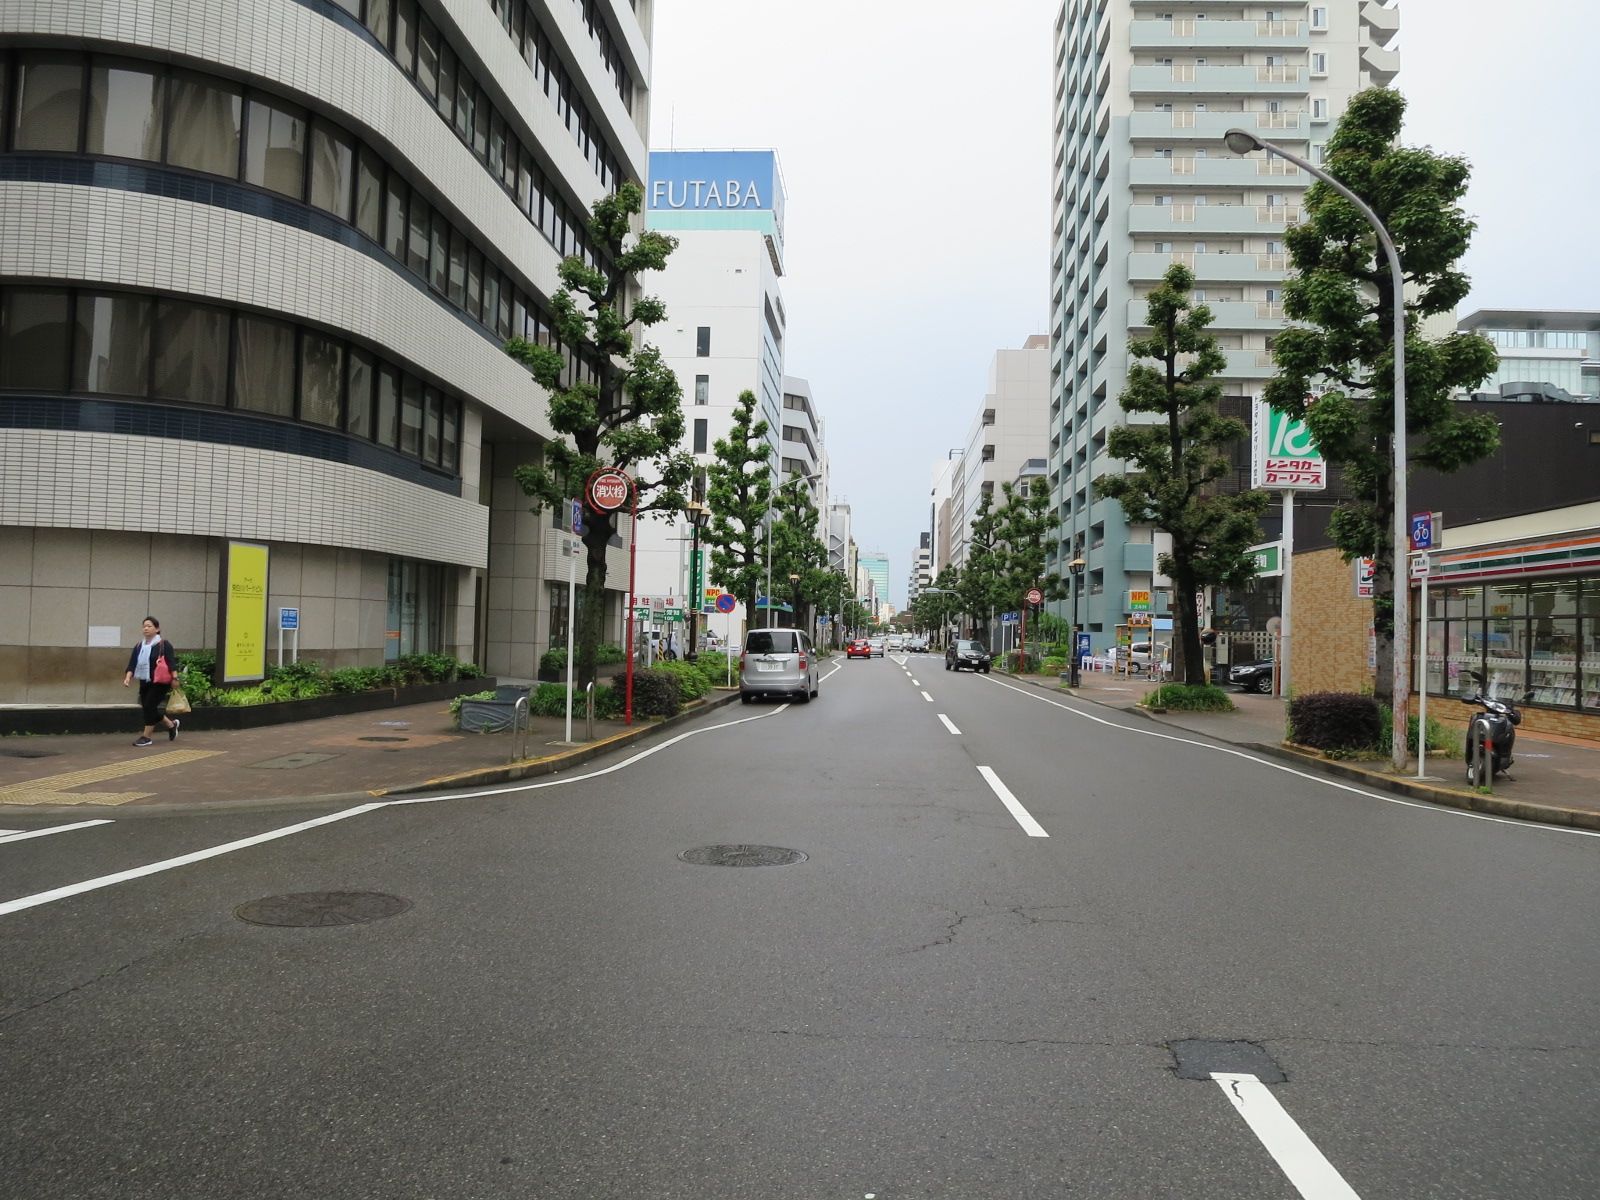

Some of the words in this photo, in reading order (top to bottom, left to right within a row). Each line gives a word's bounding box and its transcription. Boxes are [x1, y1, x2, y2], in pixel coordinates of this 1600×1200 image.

[652, 180, 761, 208] FUTABA
[1266, 459, 1322, 470] レンタカー
[1266, 473, 1322, 484] カーリース
[597, 485, 625, 498] 消火栓
[706, 589, 720, 597] NPC
[1131, 592, 1149, 601] NPC
